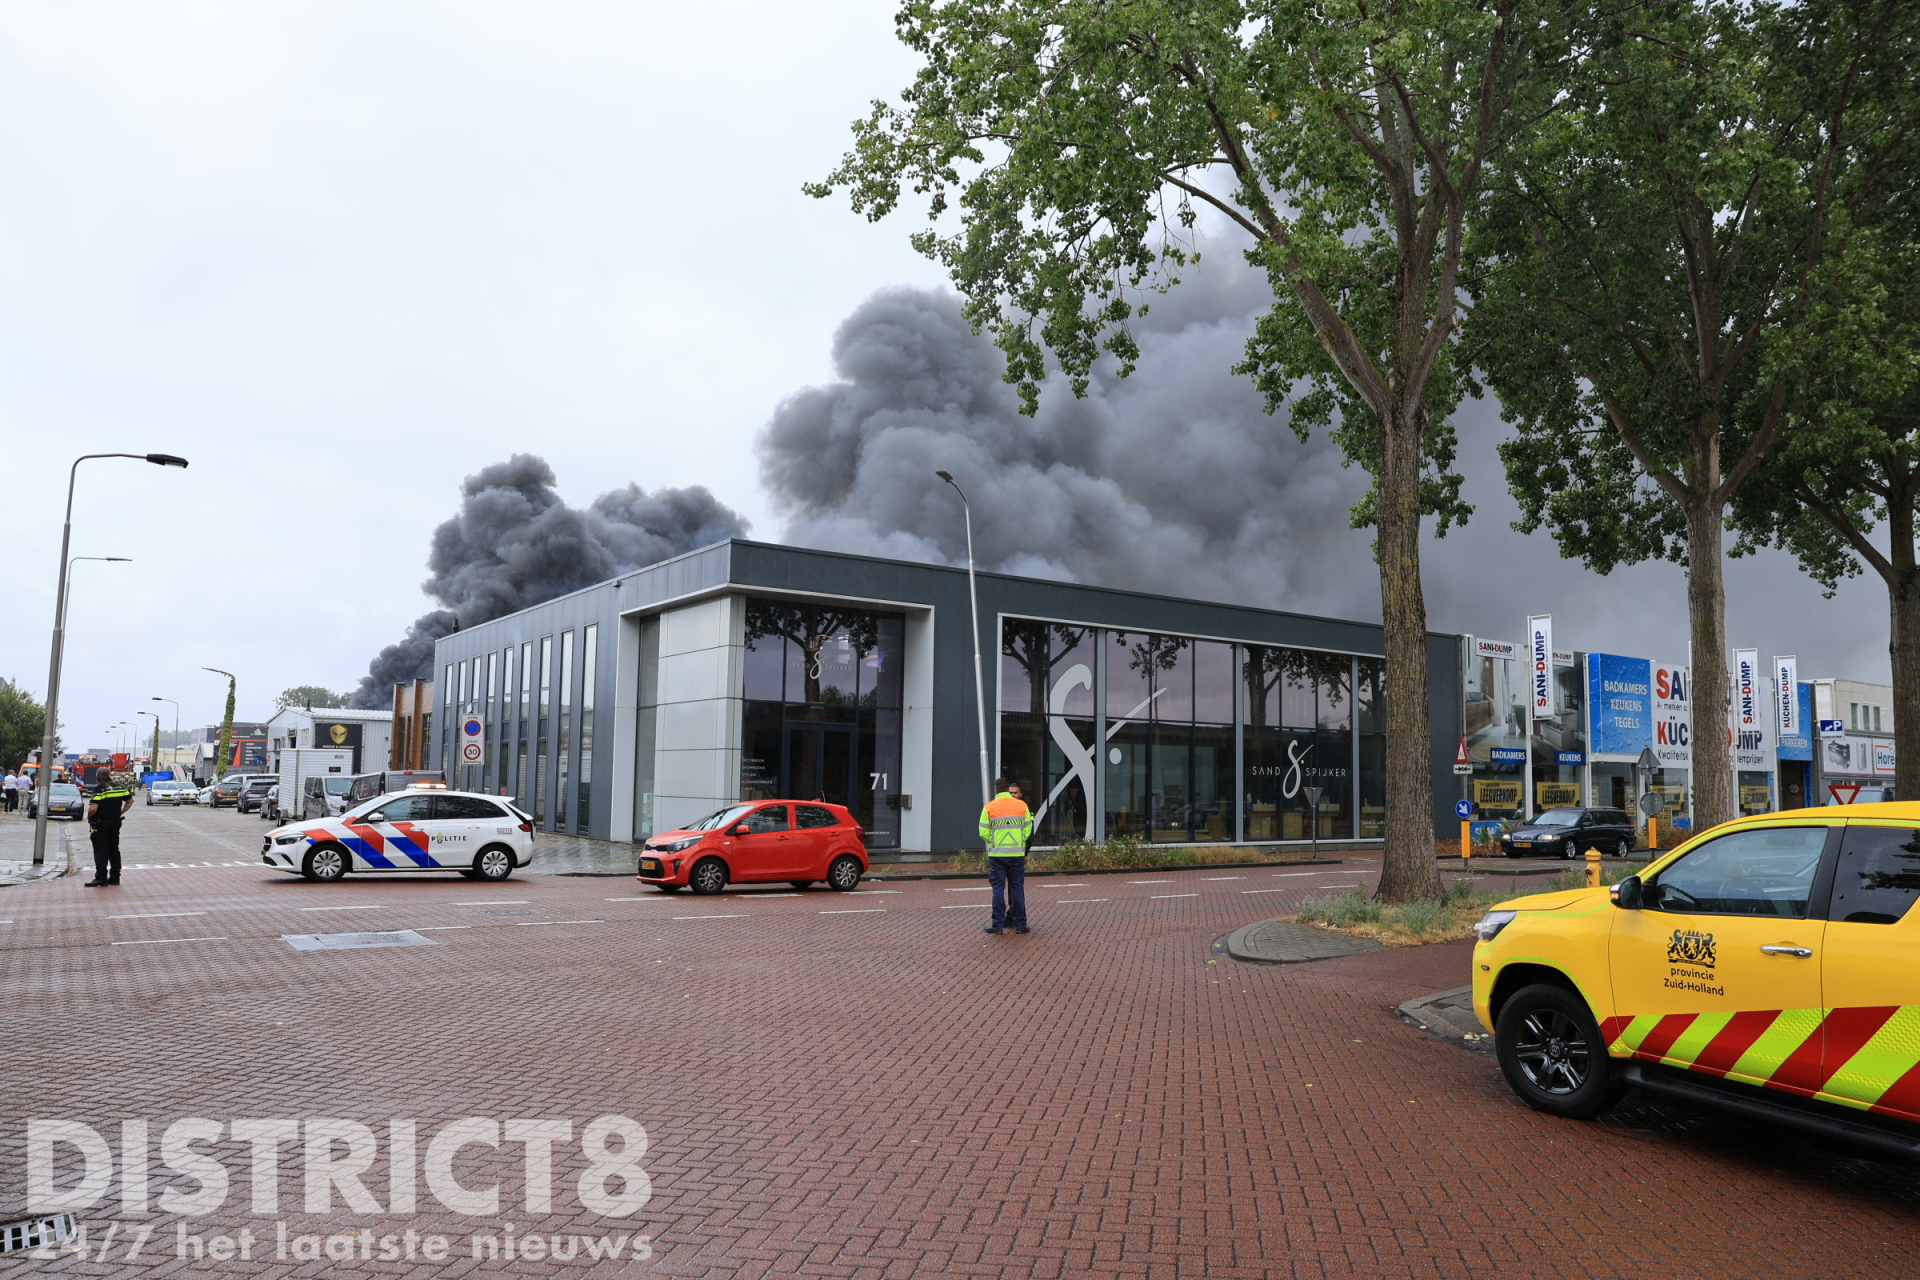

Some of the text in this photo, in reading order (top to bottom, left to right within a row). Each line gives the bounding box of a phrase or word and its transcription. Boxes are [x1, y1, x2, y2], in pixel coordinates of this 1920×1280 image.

[1478, 641, 1513, 654] SANI-DUMP
[1536, 630, 1547, 707] SANI-DUMP
[1604, 680, 1648, 695] BADKAMERS
[1741, 661, 1753, 724] SANI-DUMP
[1781, 666, 1791, 728] KÜCHEN-DUMP
[1610, 698, 1643, 712] KEUKENS
[1614, 716, 1640, 729] TEGELS
[1833, 720, 1842, 731] P
[1781, 738, 1808, 748] PARKEREN
[467, 748, 478, 756] 30
[1491, 750, 1526, 760] BADKAMERS
[1559, 753, 1582, 762] KEUKENS
[1252, 765, 1346, 777] SAND SPIJKER
[869, 772, 888, 790] 71
[1480, 787, 1518, 803] LEEGVERKOOP
[431, 835, 467, 844] POLITIE
[1670, 968, 1715, 981] provincie
[1663, 977, 1725, 996] Zuid-Holland
